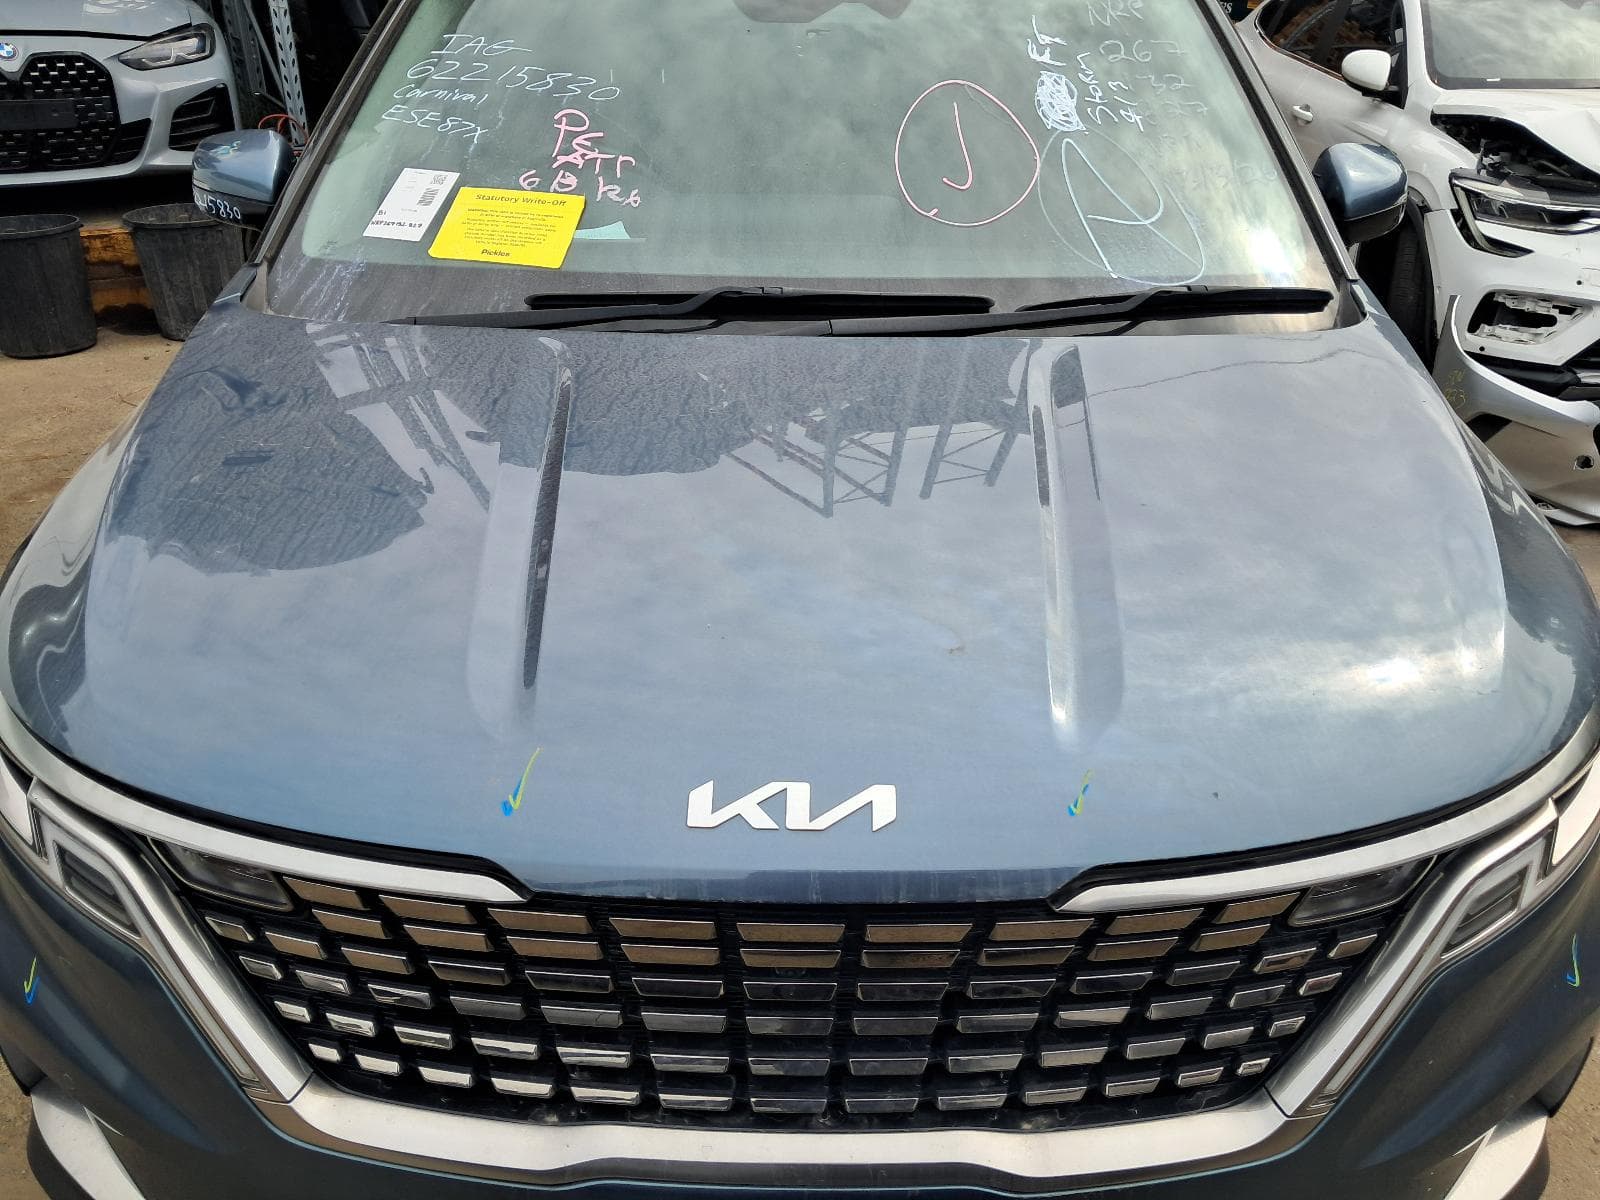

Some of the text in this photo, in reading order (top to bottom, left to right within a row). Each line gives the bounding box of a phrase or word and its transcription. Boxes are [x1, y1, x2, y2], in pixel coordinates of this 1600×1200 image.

[430, 34, 533, 56] IAG
[406, 58, 621, 101] 62215830
[475, 194, 567, 207] Statutory Write-Off
[481, 248, 510, 257] Pickles
[686, 779, 897, 832] KIA
